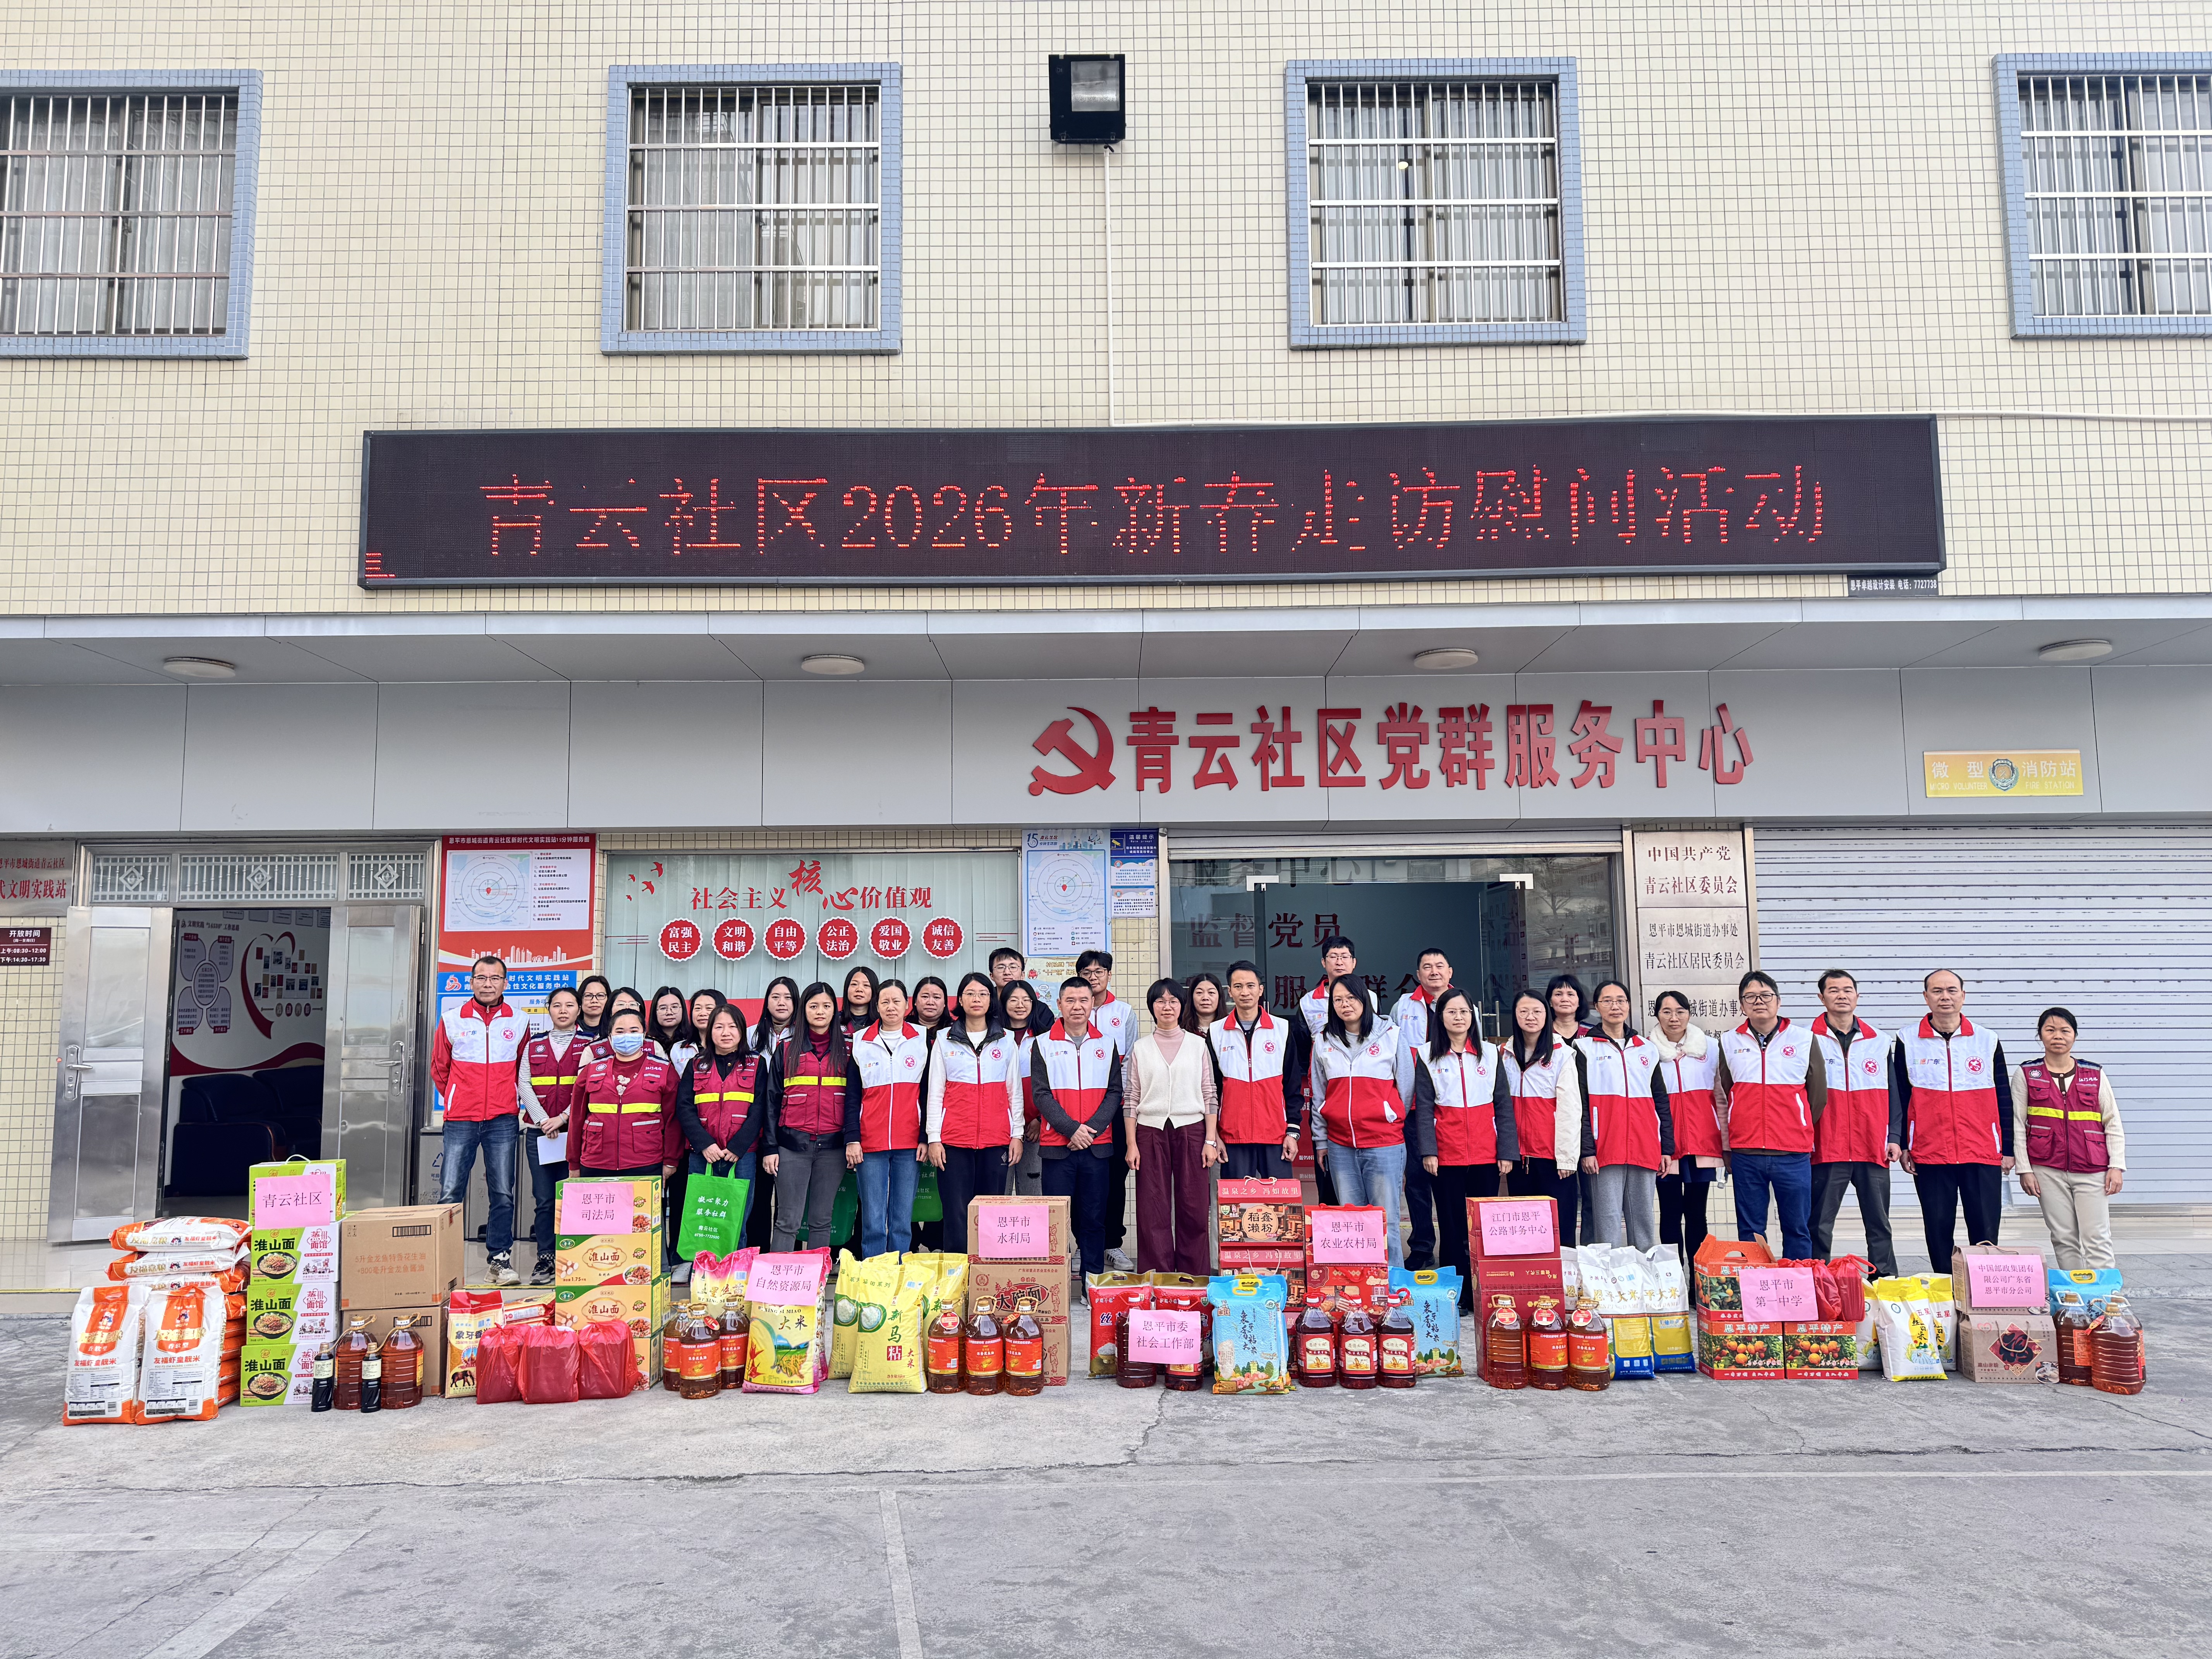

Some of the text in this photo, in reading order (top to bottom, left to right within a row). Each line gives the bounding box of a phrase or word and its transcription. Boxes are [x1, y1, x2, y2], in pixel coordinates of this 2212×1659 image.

[1851, 580, 1895, 591] 恩平卓越设计安装
[1127, 700, 1755, 792] 青云社区党群服务中心
[2022, 760, 2076, 778] 消防站
[2026, 781, 2039, 790] FIRE
[1648, 846, 1731, 861] 中国共产党
[691, 859, 932, 910] 社会主义核心价值观
[1645, 876, 1737, 894] 青云社区委员会
[668, 927, 692, 938] 富强
[723, 926, 745, 938] 文明
[774, 926, 797, 937] 自由
[826, 926, 849, 937] 公正
[879, 925, 902, 936] 爱国
[931, 925, 954, 936] 诚信
[1189, 913, 1341, 948] 监督党员
[1649, 923, 1738, 937] 恩平市恩城街道办事处
[668, 940, 692, 953] 民主
[721, 940, 745, 952] 和谐
[773, 939, 797, 952] 平等
[826, 939, 849, 951] 法治
[879, 939, 903, 951] 敬业
[931, 939, 954, 951] 友善
[1645, 951, 1745, 969] 青云社区居民委员会
[464, 982, 569, 990] 青合性文化服务中心
[1648, 1000, 1747, 1017] 恩城街道办事
[1263, 1187, 1298, 1195] 冯如故里
[263, 1192, 322, 1207] 青云社区
[582, 1194, 615, 1204] 恩平市
[581, 1209, 614, 1221] 司法局
[1492, 1211, 1540, 1222] 江门市恩平
[998, 1216, 1030, 1228] 恩平市
[1331, 1222, 1364, 1233] 恩平市
[1489, 1225, 1547, 1236] 公路事务中心
[998, 1232, 1030, 1244] 水利局
[1321, 1237, 1376, 1249] 农业农村局
[254, 1238, 295, 1251] 淮山面
[355, 1252, 426, 1263] 5升金龙鱼特香花生油
[589, 1252, 620, 1262] 淮山面
[1266, 1251, 1301, 1259] 冯如故里
[771, 1265, 804, 1276] 恩平市
[1978, 1264, 2033, 1273] 中国邮政集团有
[756, 1278, 811, 1292] 自然资源局
[1760, 1279, 1793, 1291] 恩平市
[1984, 1276, 2031, 1284] 限公司广东省
[1594, 1286, 1680, 1303] 恩平大米 平大米
[1985, 1286, 2032, 1295] 恩平市分公司
[251, 1297, 291, 1311] 淮山面
[1755, 1295, 1802, 1308] 第一中学
[589, 1305, 619, 1314] 淮山面
[779, 1315, 807, 1330] 大米
[1143, 1321, 1188, 1332] 恩平市委
[1724, 1324, 1770, 1333] 恩平特产
[1797, 1324, 1843, 1333] 恩平特产
[1137, 1336, 1194, 1350] 社会工作部
[154, 1355, 200, 1364] 友福虾皇靓米
[907, 1348, 914, 1368] 大米
[245, 1358, 286, 1372] 淮山面
